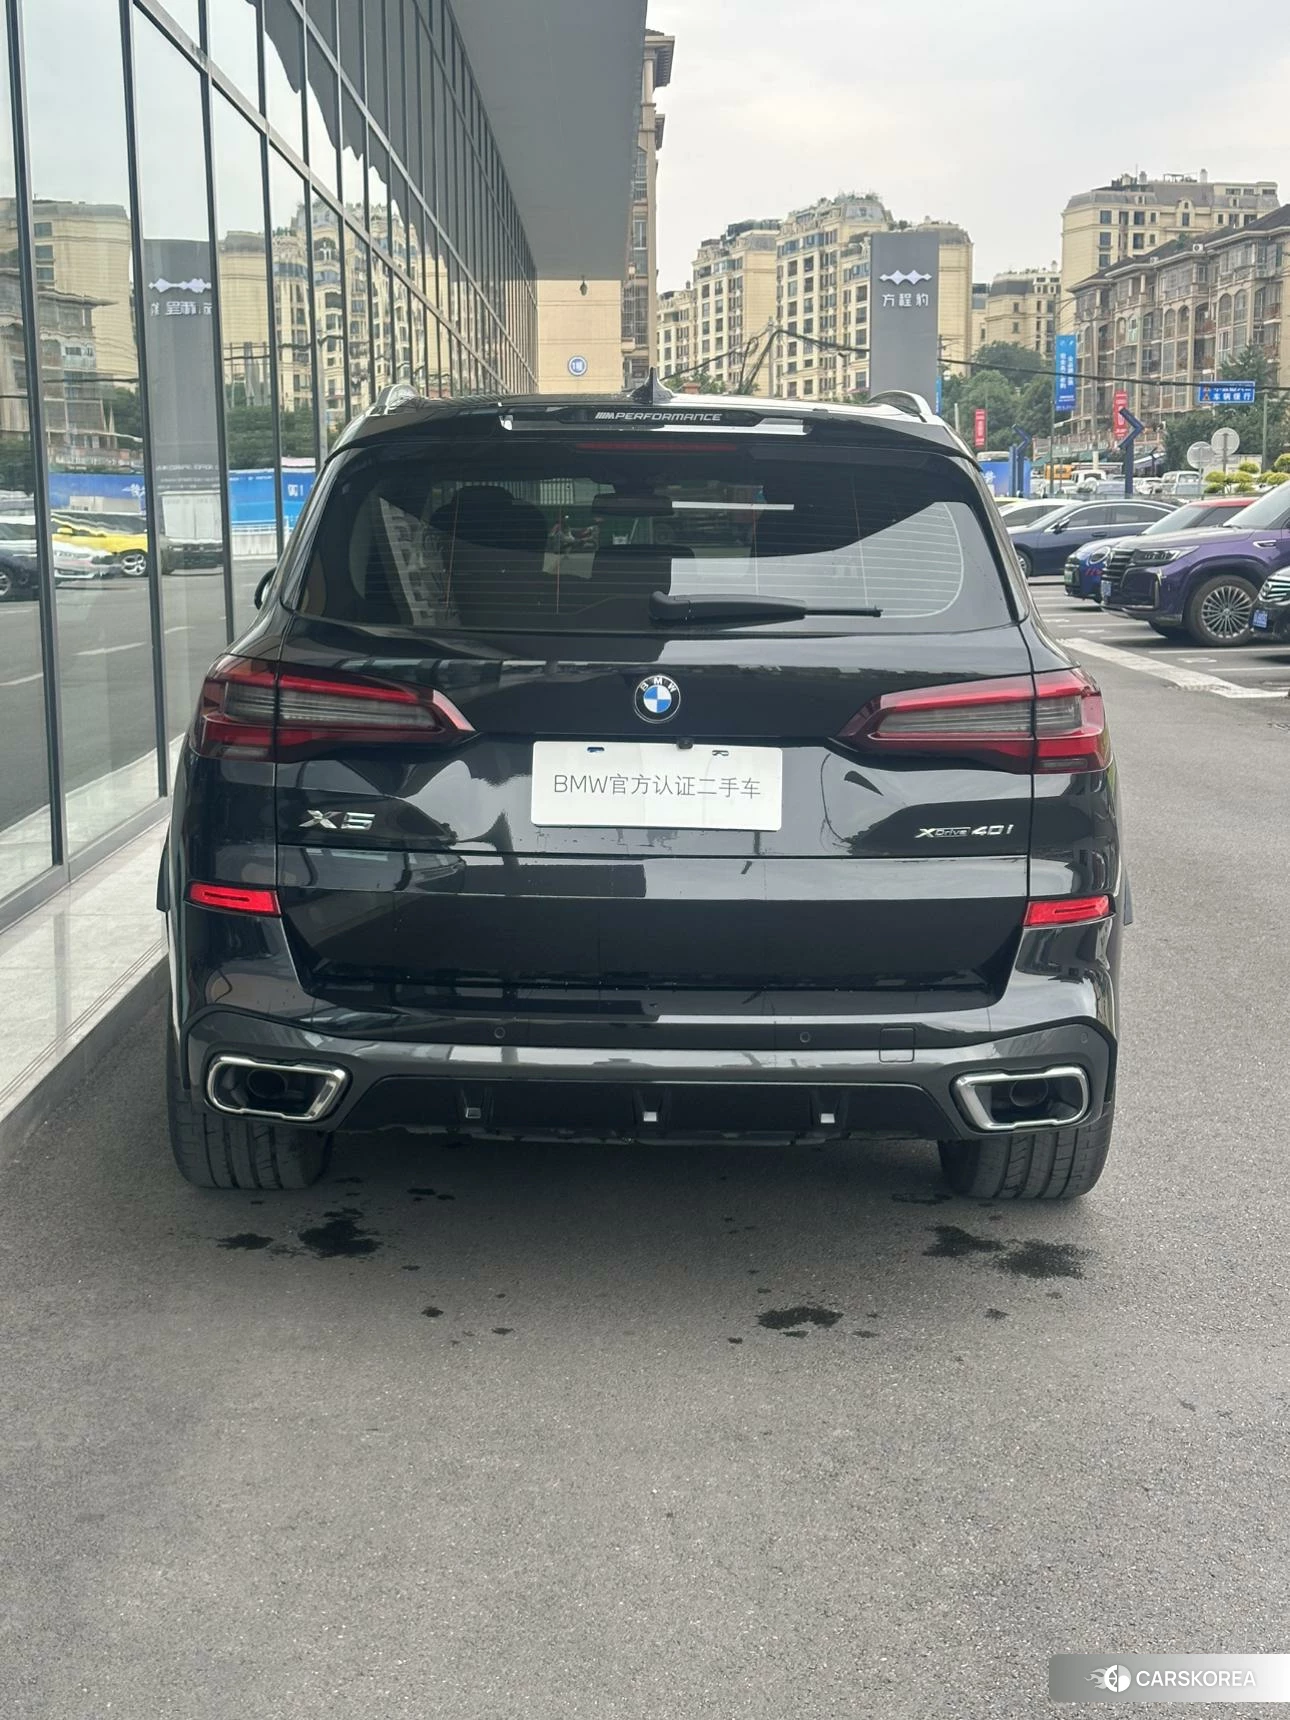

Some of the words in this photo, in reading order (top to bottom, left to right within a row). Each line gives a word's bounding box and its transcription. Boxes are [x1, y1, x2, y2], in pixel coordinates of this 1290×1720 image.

[882, 293, 929, 307] 方程豹
[614, 412, 723, 421] PERFORMANCE
[640, 677, 677, 693] BMW
[553, 774, 761, 799] BMW官方认证二手车
[299, 809, 376, 831] X5
